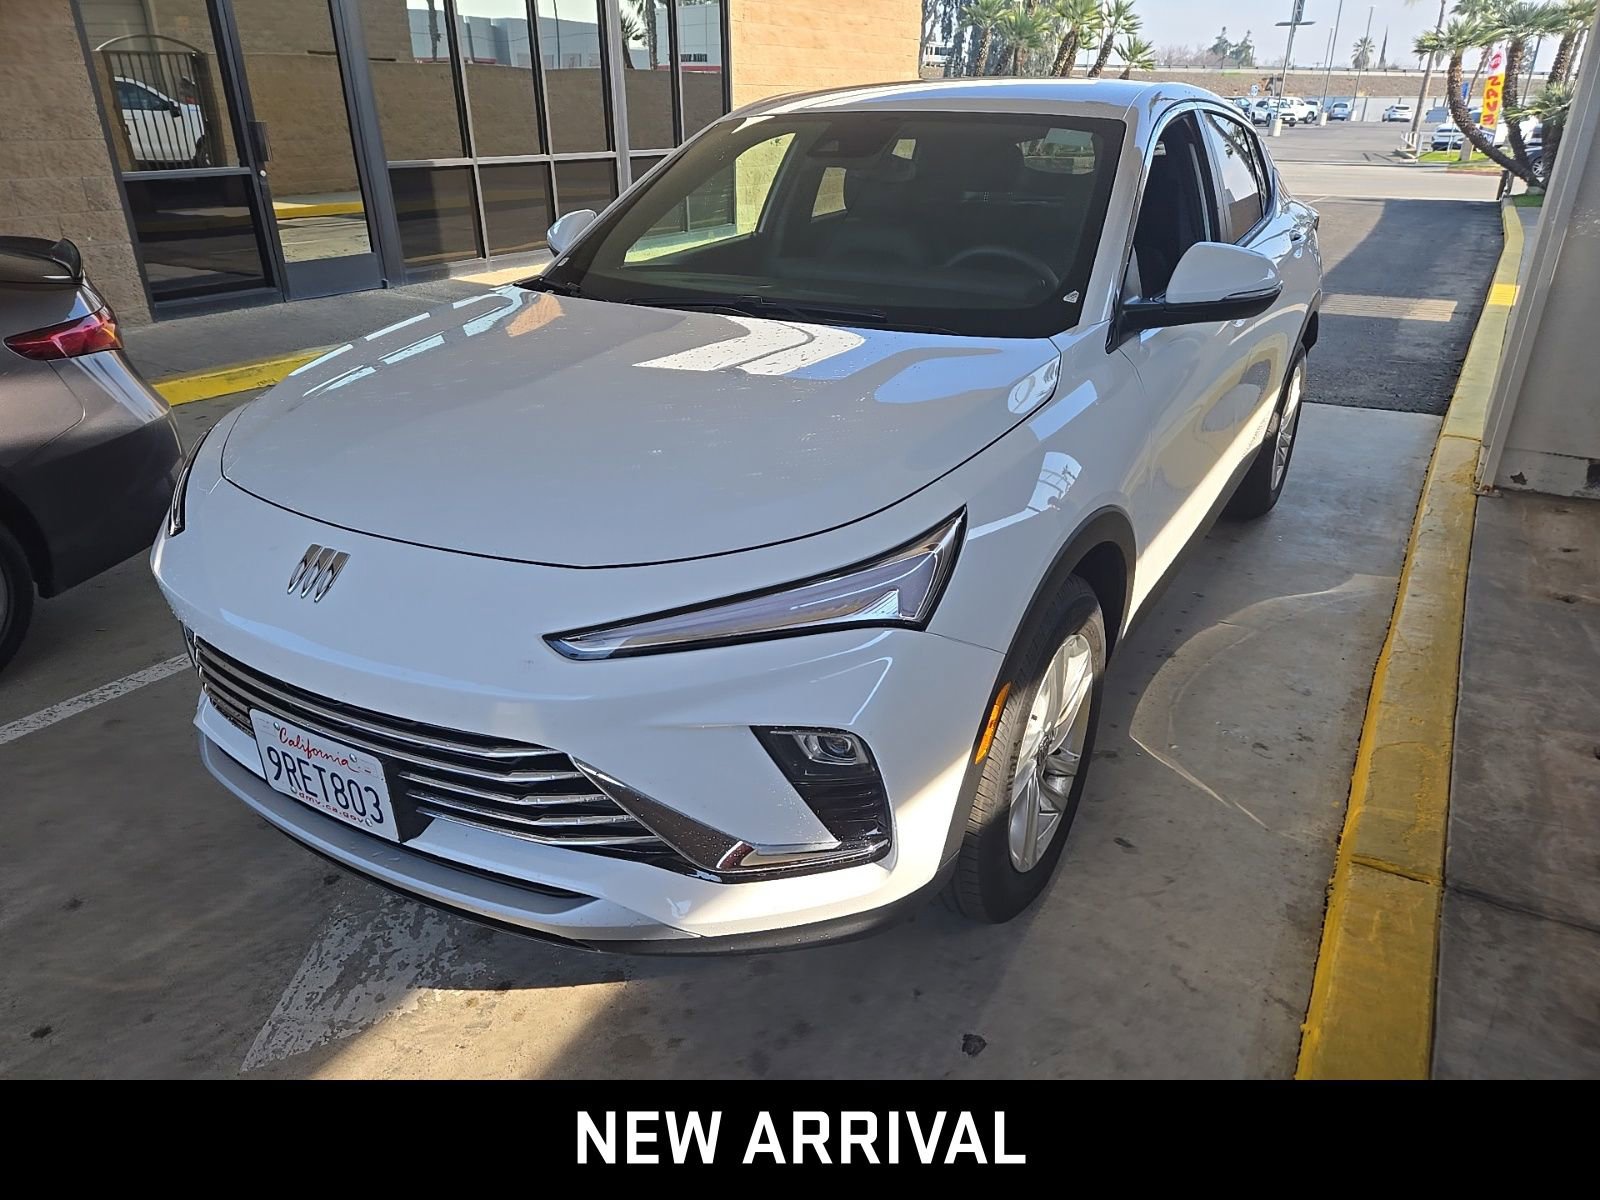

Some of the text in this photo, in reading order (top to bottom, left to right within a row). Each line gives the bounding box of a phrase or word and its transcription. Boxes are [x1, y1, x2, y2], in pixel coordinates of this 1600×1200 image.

[279, 727, 360, 773] California
[266, 746, 384, 824] 9RET803
[298, 791, 364, 823] dmv.ca.gov
